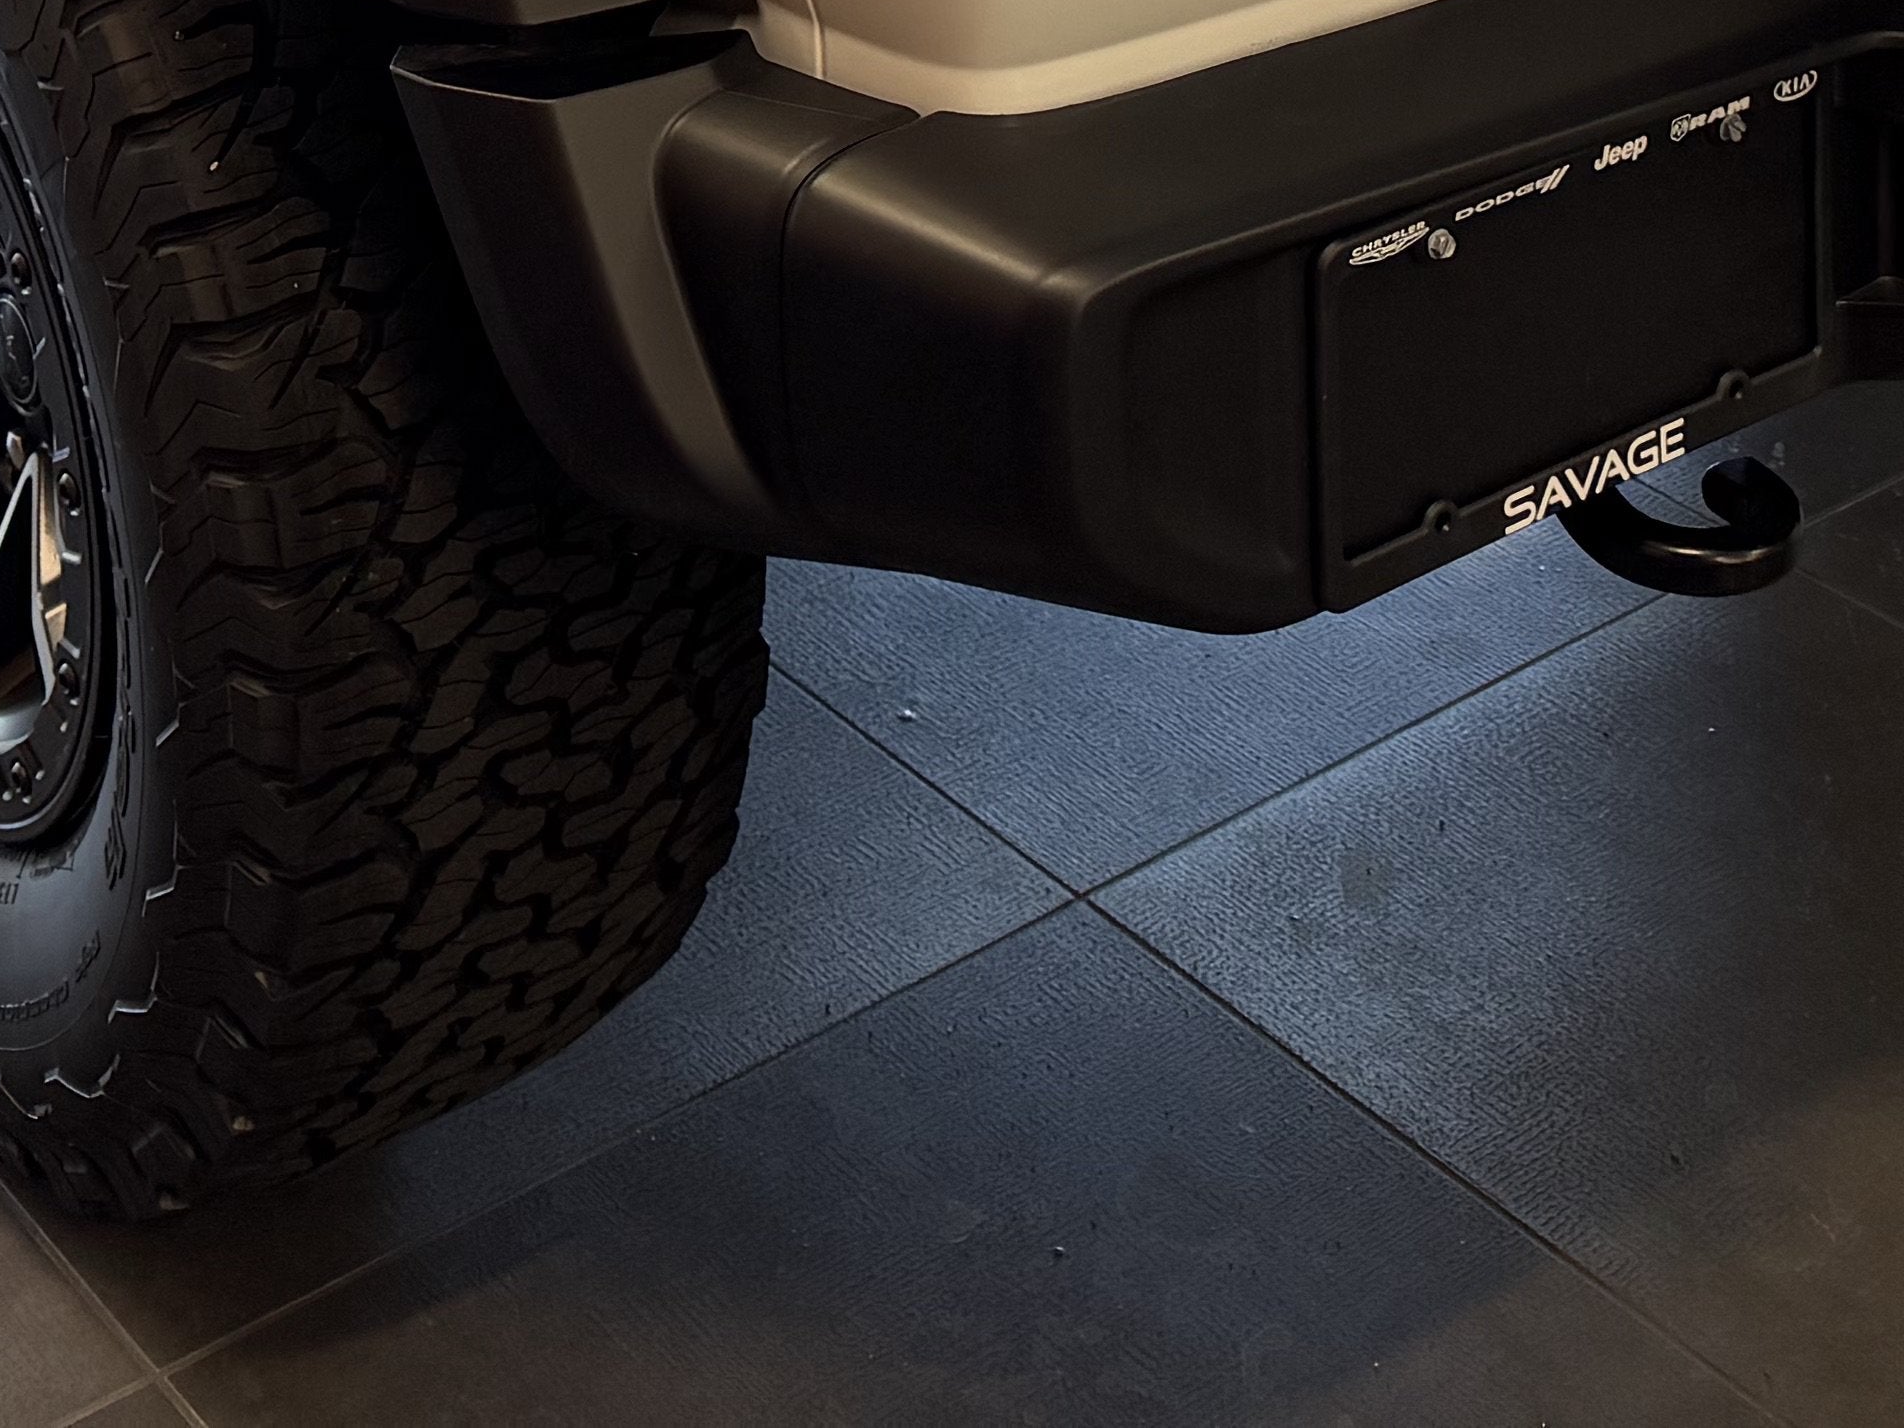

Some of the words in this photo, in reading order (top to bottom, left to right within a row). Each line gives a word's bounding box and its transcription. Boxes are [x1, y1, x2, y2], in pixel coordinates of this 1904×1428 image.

[1351, 220, 1427, 258] CHRYSLER
[1594, 135, 1648, 171] Jeep
[1688, 95, 1751, 131] RAM
[1780, 72, 1813, 98] KIA
[1503, 416, 1686, 536] SAVAGE
